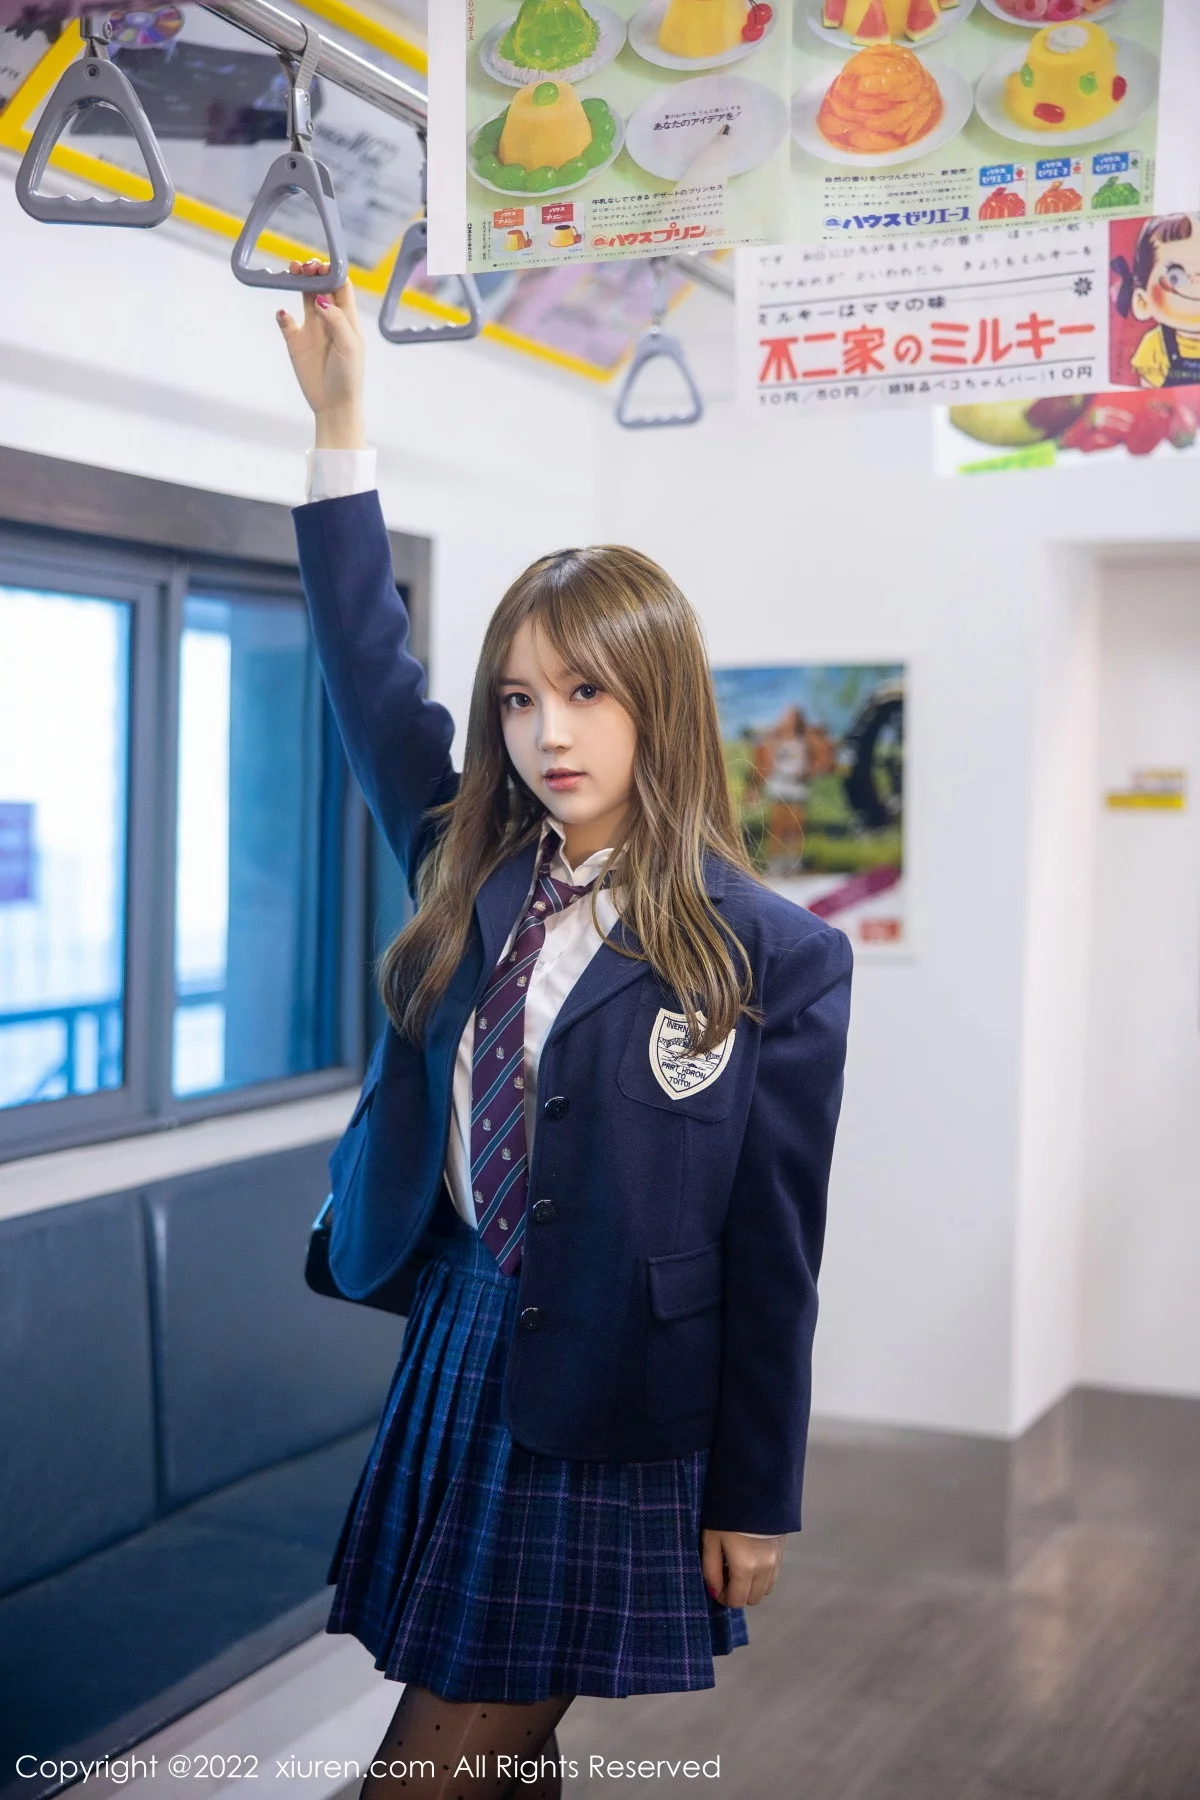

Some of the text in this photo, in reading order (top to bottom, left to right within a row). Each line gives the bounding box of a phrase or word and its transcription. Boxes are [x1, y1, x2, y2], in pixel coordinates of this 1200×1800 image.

[608, 222, 706, 247] ハウスプリン
[759, 311, 1096, 383] 不二家のミルキー
[677, 1072, 687, 1080] TO
